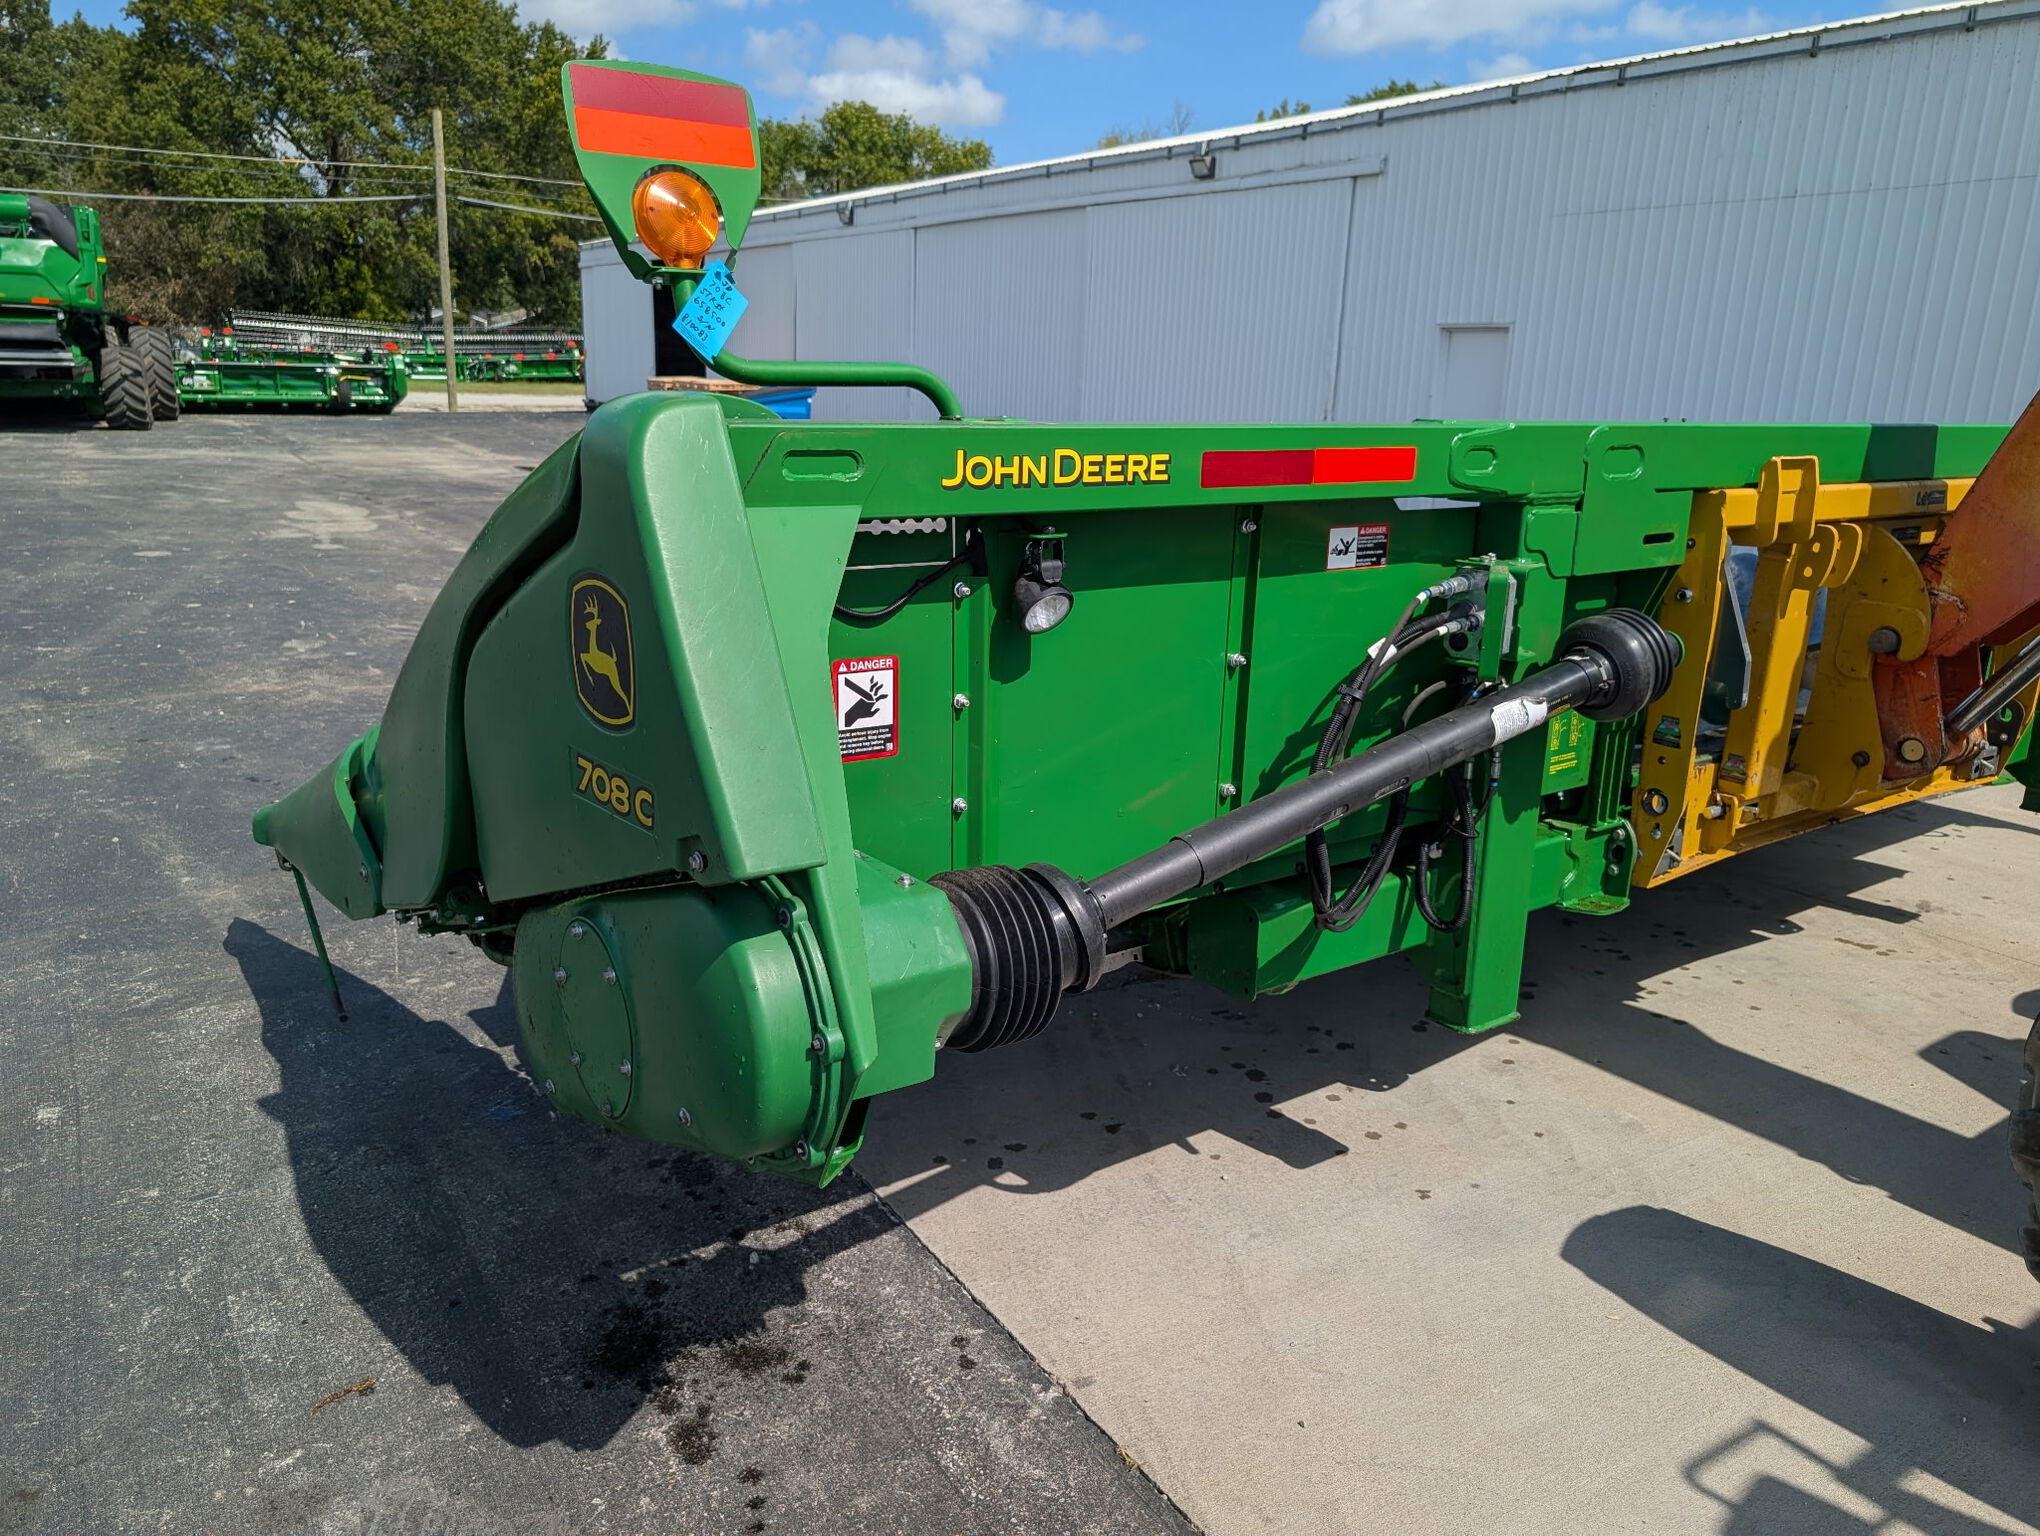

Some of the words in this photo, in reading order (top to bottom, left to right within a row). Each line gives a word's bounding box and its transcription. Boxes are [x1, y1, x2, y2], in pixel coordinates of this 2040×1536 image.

[709, 280, 732, 305] 708C
[693, 297, 726, 327] 658500
[941, 449, 1049, 490] JOHN
[1053, 448, 1171, 487] DEERE
[1366, 526, 1387, 535] DANGER
[850, 658, 893, 672] DANGER
